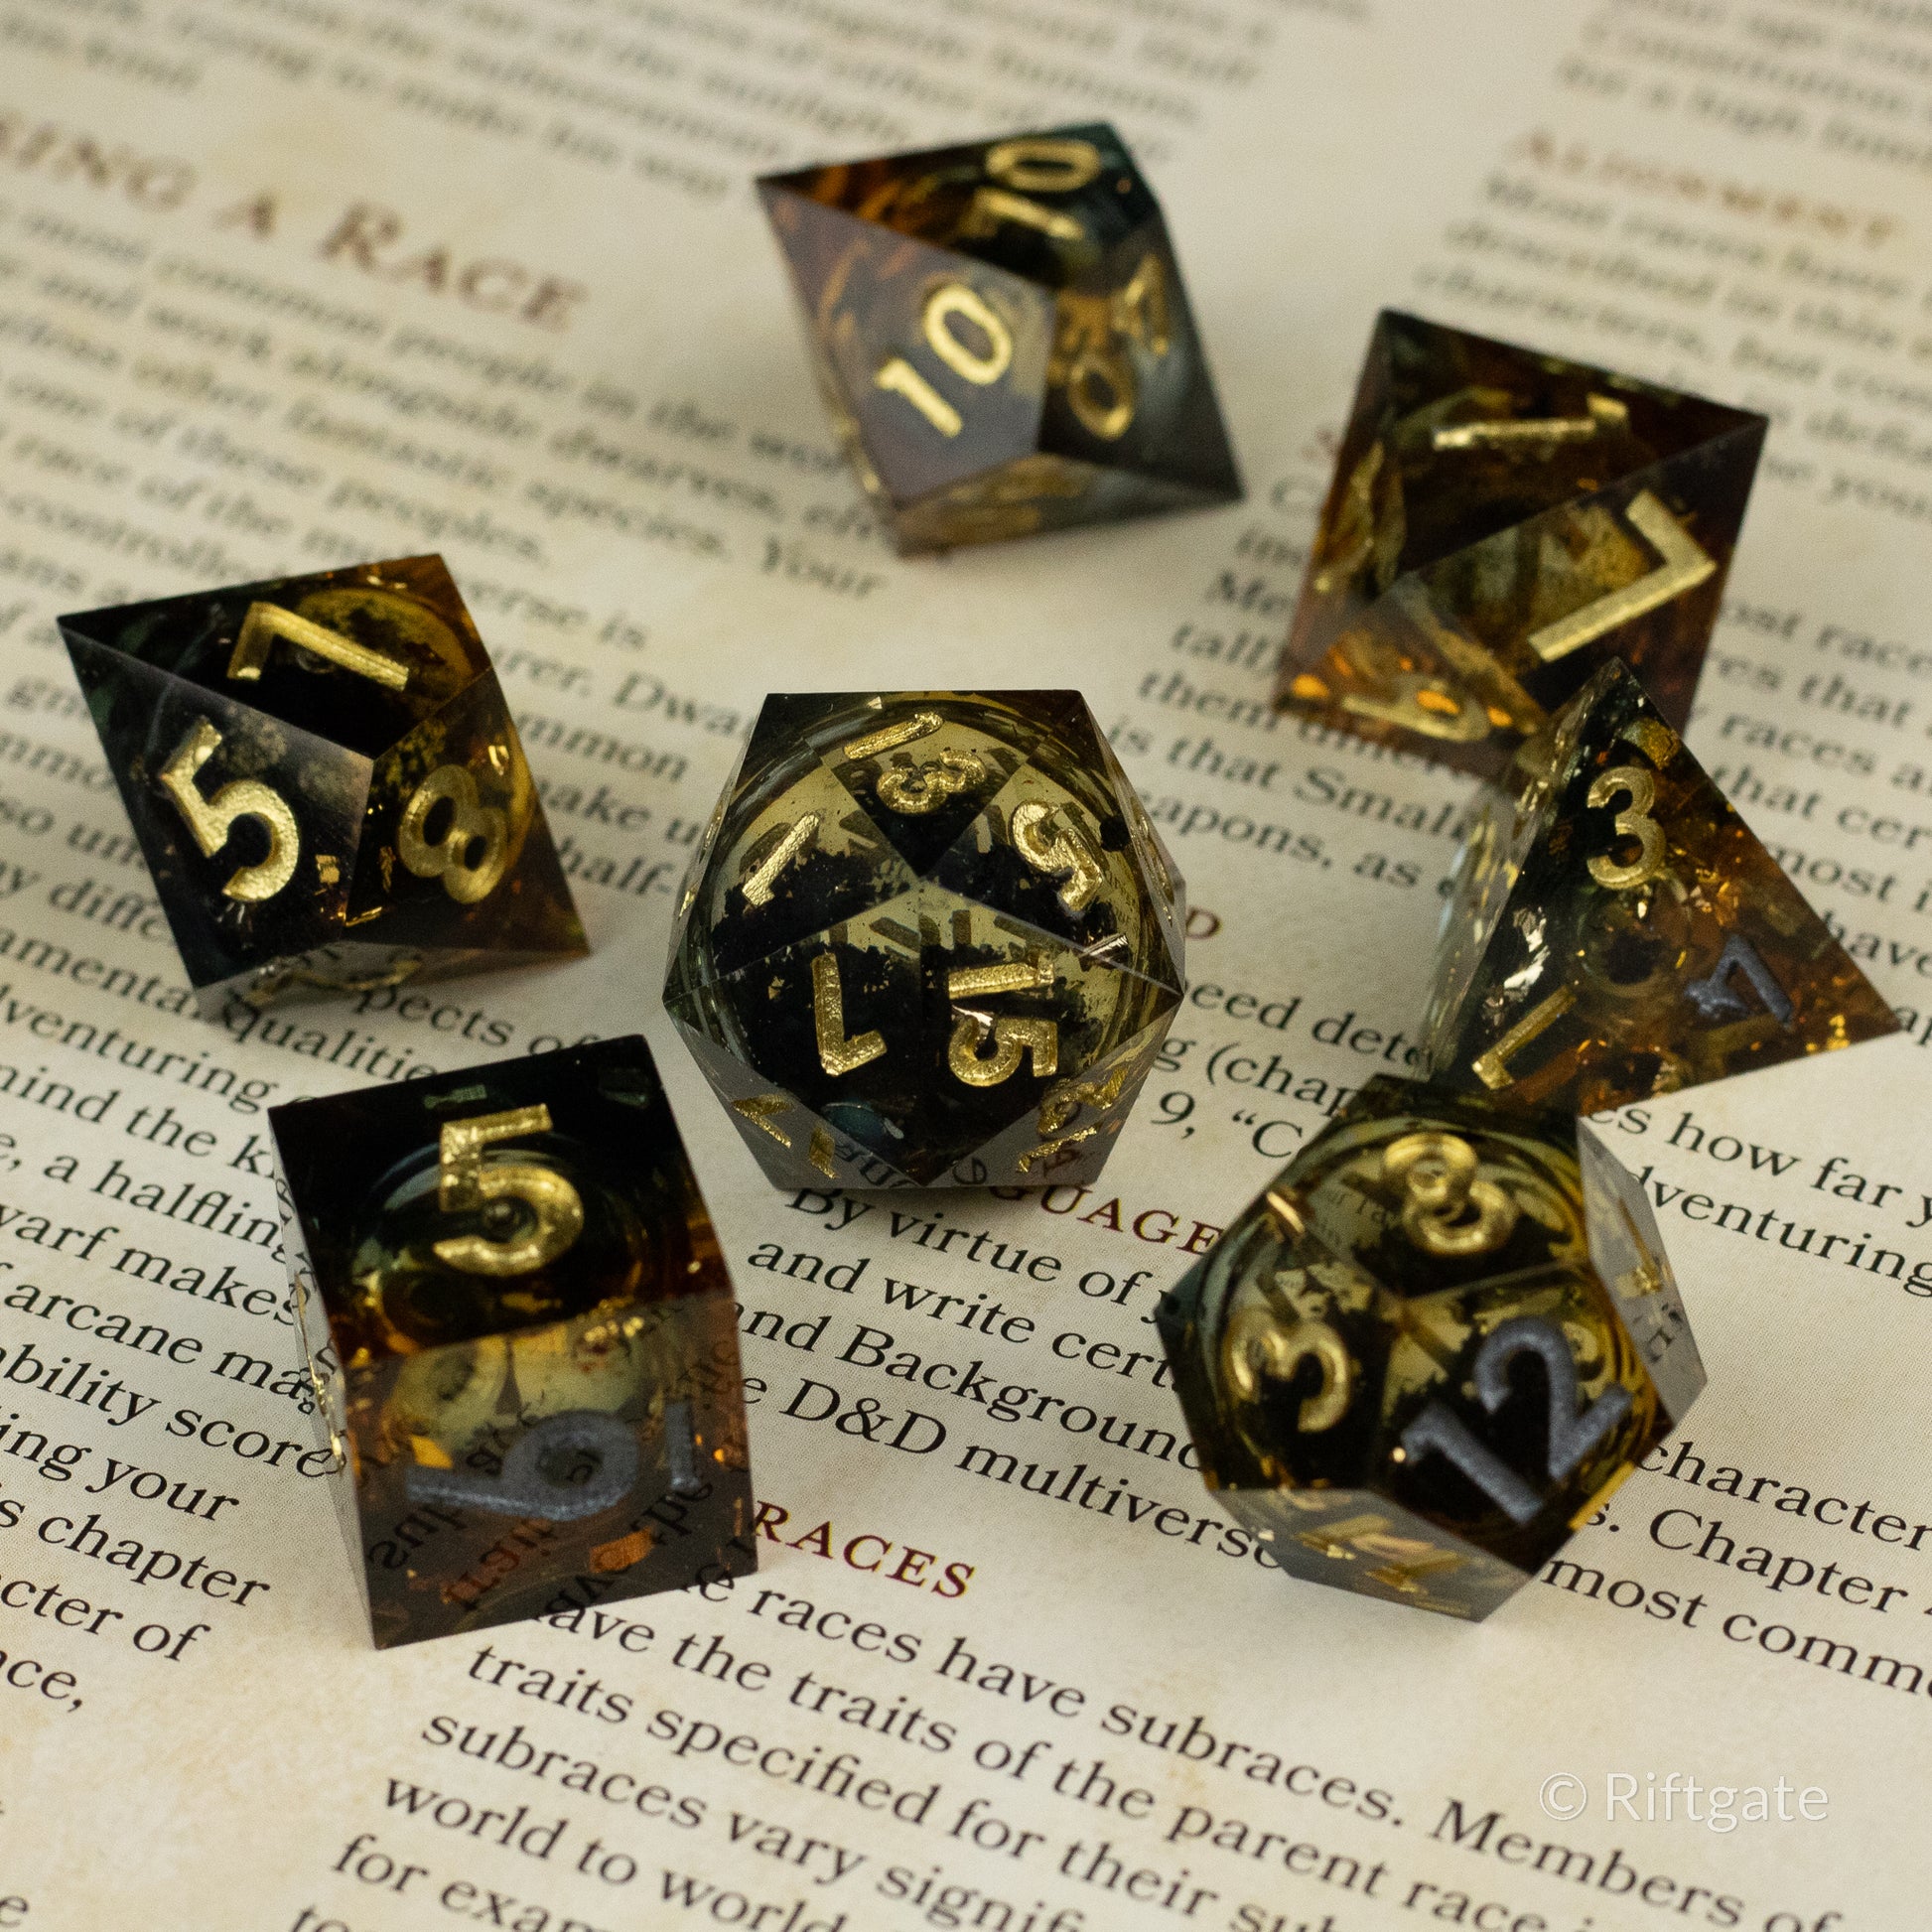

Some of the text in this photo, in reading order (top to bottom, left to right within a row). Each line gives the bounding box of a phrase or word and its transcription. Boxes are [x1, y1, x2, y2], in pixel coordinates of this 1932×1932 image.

[212, 189, 280, 241] A
[316, 199, 589, 333] RACE
[286, 352, 542, 439] alongside
[395, 323, 574, 399] people
[875, 282, 1015, 440] 10
[284, 397, 505, 488] fantastic
[524, 479, 731, 561] species.
[759, 533, 886, 599] Your
[1528, 488, 1718, 663] 7
[227, 602, 409, 692] 7
[516, 709, 691, 782] mmon
[1722, 711, 1874, 777] races
[1802, 673, 1913, 730] that
[159, 715, 300, 901] 5
[1168, 737, 1281, 789] that
[399, 762, 509, 905] 8
[1353, 851, 1423, 890] as
[1587, 765, 1667, 890] 3
[1837, 806, 1932, 852] cer
[220, 996, 437, 1084] qualitie
[947, 950, 1058, 1088] 15
[1185, 981, 1303, 1031] eed
[1470, 985, 1577, 1090] 1
[125, 1107, 217, 1158] the
[1152, 1092, 1195, 1139] 9,
[1667, 1112, 1802, 1175] how
[1811, 1158, 1902, 1210] far
[44, 1154, 80, 1184] a
[433, 1102, 585, 1278] 5
[1384, 1130, 1517, 1257] 8
[109, 1245, 298, 1327] makes
[785, 1188, 1153, 1309] By virtue of
[8, 1284, 204, 1366] arcane
[747, 1241, 1176, 1394] and write cert
[779, 1377, 948, 1454] D&D
[1224, 1305, 1349, 1434] 3
[166, 1412, 347, 1479] score
[1400, 1316, 1633, 1525] 12
[86, 1459, 240, 1520] your
[38, 1512, 272, 1606] chapter
[754, 1501, 975, 1600] RACES
[1647, 1505, 1910, 1613] Chapter
[133, 1622, 211, 1662] of
[1541, 1556, 1932, 1699] most comm
[421, 1715, 709, 1830] subraces
[728, 1809, 868, 1886] vary
[468, 1644, 635, 1725] traits
[645, 1707, 942, 1828] specified
[947, 1798, 1046, 1863] for
[1059, 1841, 1219, 1921] their
[531, 1603, 655, 1654] ave
[671, 1634, 772, 1692] the
[789, 1670, 957, 1755] traits
[974, 1739, 1052, 1781] of
[1052, 1759, 1156, 1821] the
[1163, 1803, 1392, 1902] parent
[749, 1589, 922, 1663] races
[935, 1636, 1086, 1718] have
[1102, 1703, 1404, 1828] subraces.
[1430, 1797, 1745, 1928] Members
[333, 1833, 430, 1894] for
[384, 1776, 849, 1932] world to world
